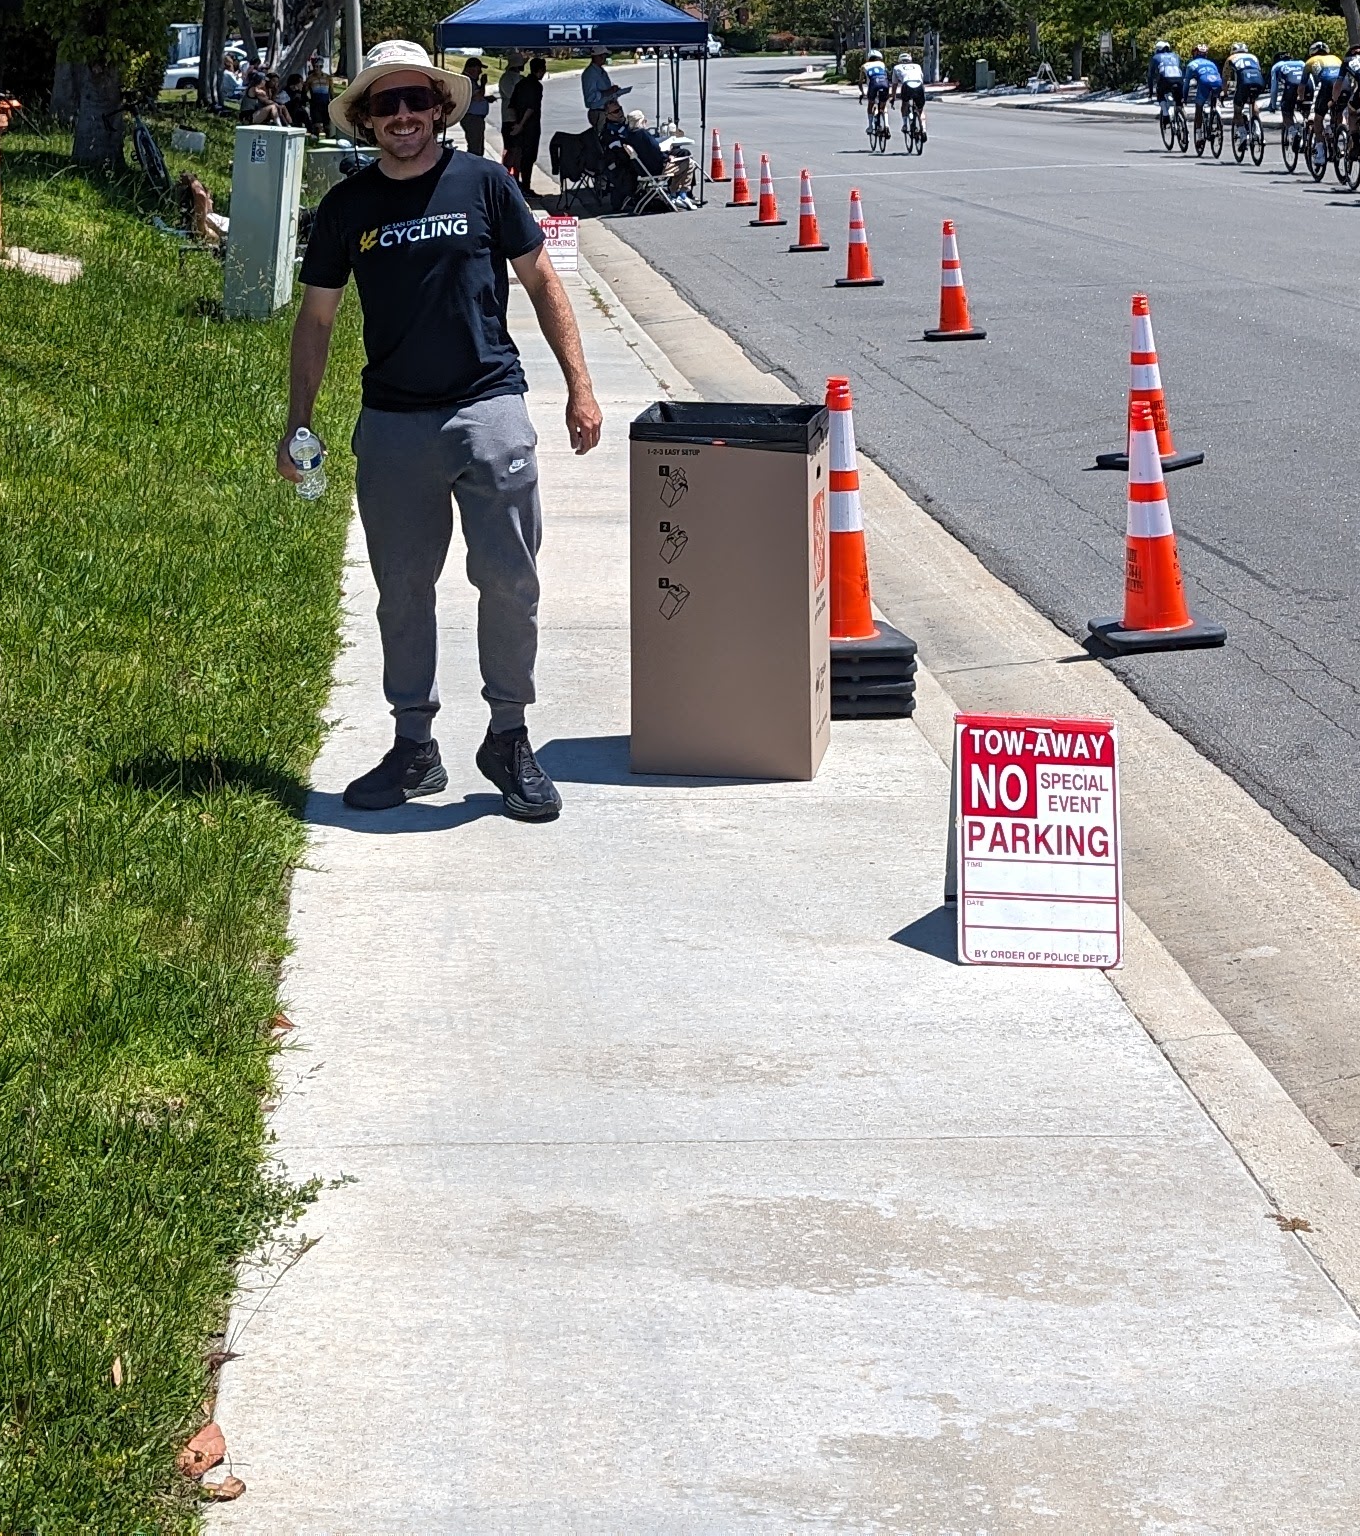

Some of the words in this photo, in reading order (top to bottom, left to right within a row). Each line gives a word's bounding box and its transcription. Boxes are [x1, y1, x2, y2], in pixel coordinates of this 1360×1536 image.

[549, 25, 593, 39] PRT
[392, 221, 405, 229] SAN
[407, 217, 427, 227] DIEGO
[428, 213, 467, 222] RECREATION
[380, 220, 468, 247] CYCLING
[542, 227, 557, 237] NO
[970, 730, 1105, 760] TOW-AWAY
[971, 763, 1028, 812] NO
[1040, 773, 1108, 792] SPECIAL
[1048, 795, 1102, 814] EVENT
[968, 822, 1109, 857] PARKING
[974, 950, 988, 959] BY
[990, 950, 1025, 960] ORDER
[1028, 952, 1042, 961] OF
[1044, 952, 1080, 962] POLICE
[1082, 953, 1112, 964] DEPT.
